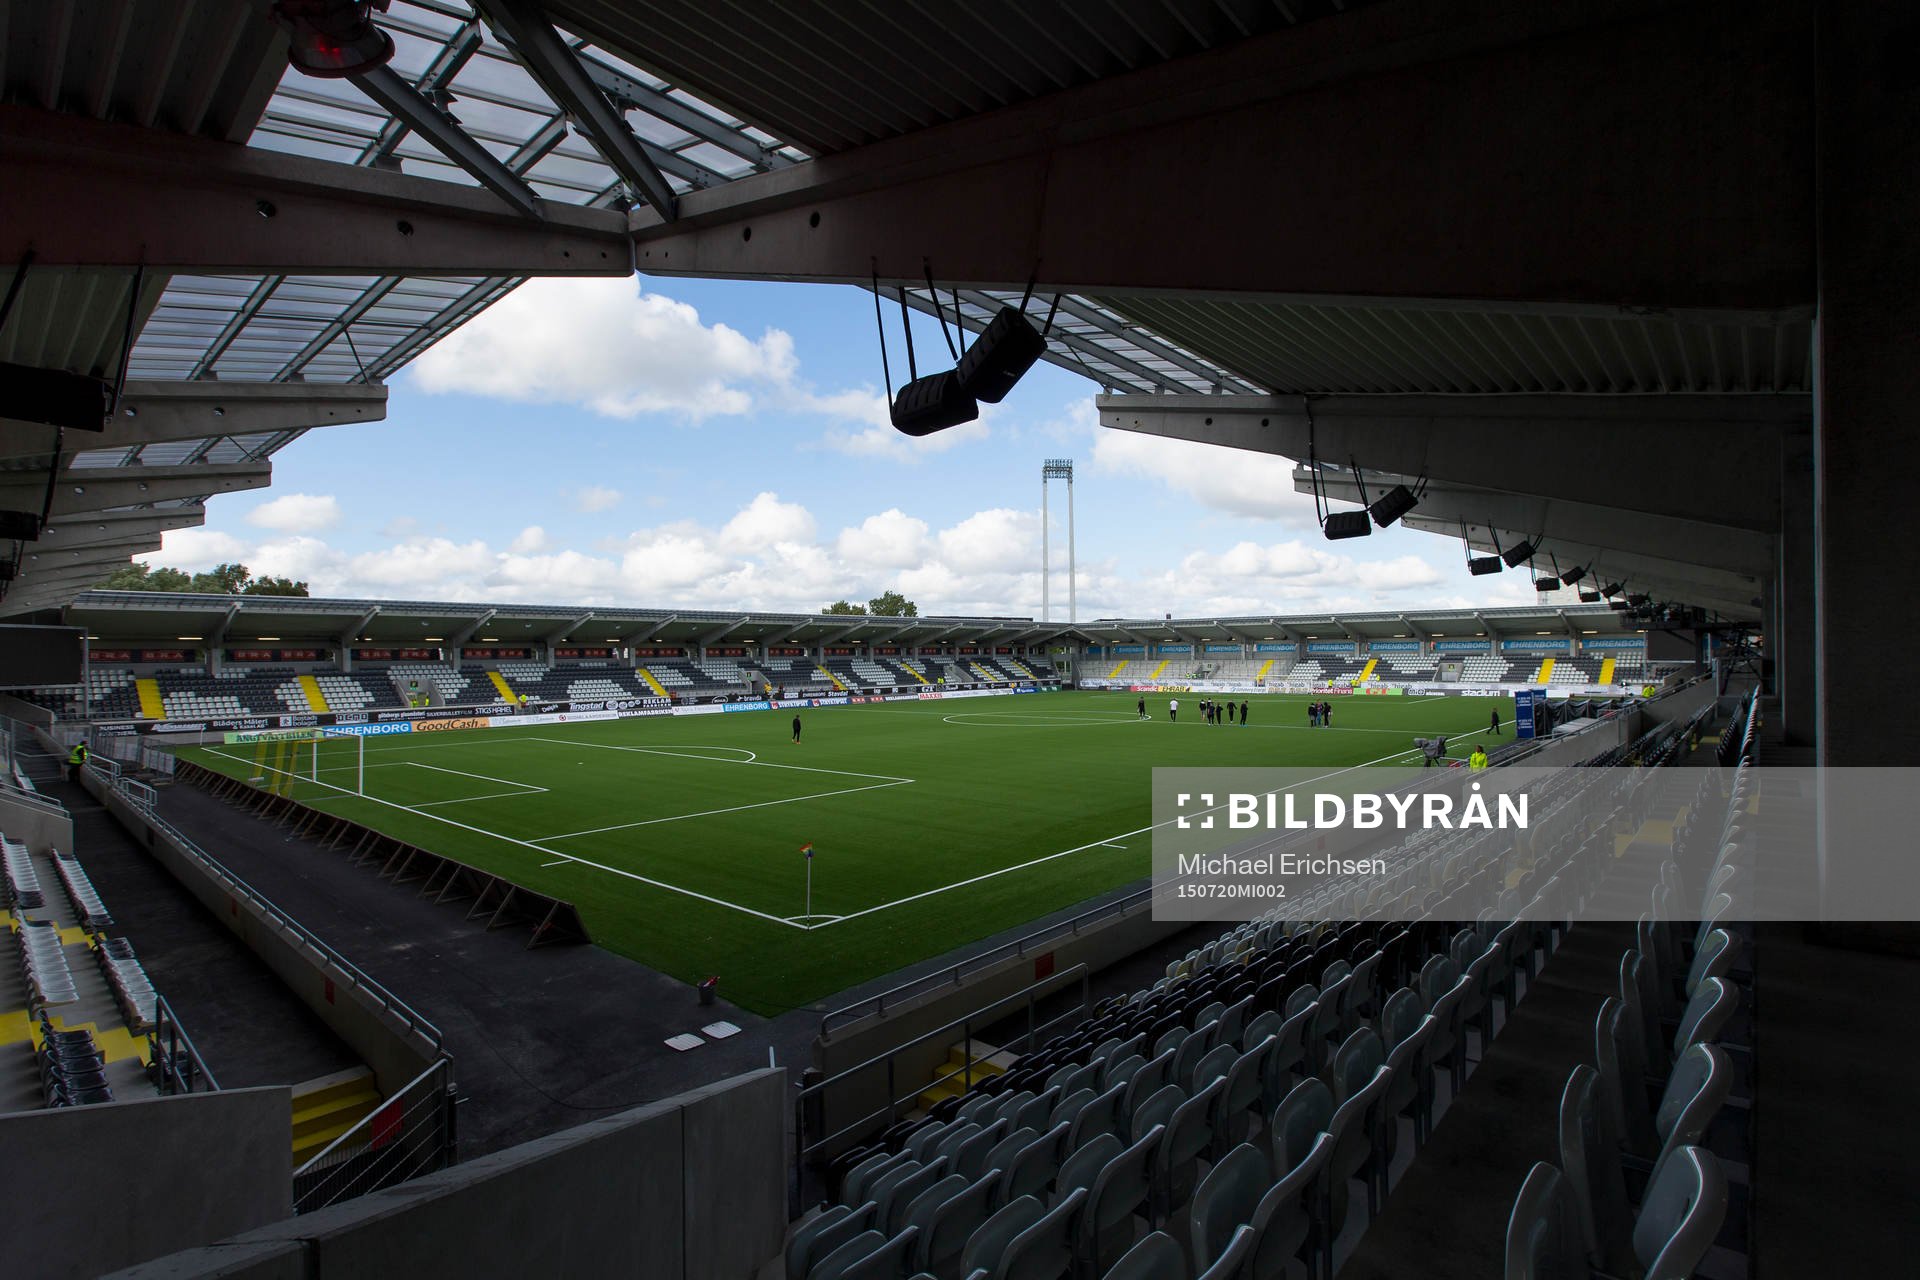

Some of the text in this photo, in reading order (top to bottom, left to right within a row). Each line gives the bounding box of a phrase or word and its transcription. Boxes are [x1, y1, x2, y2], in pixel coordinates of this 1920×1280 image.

[1373, 642, 1418, 650] EHRENBORG
[1510, 641, 1565, 649] EHRENBORG
[1460, 689, 1500, 697] stadium
[568, 702, 604, 712] Tingstad
[725, 702, 768, 712] EHRENBORG
[326, 723, 409, 737] EHRENBORG
[417, 719, 478, 732] GoodCash
